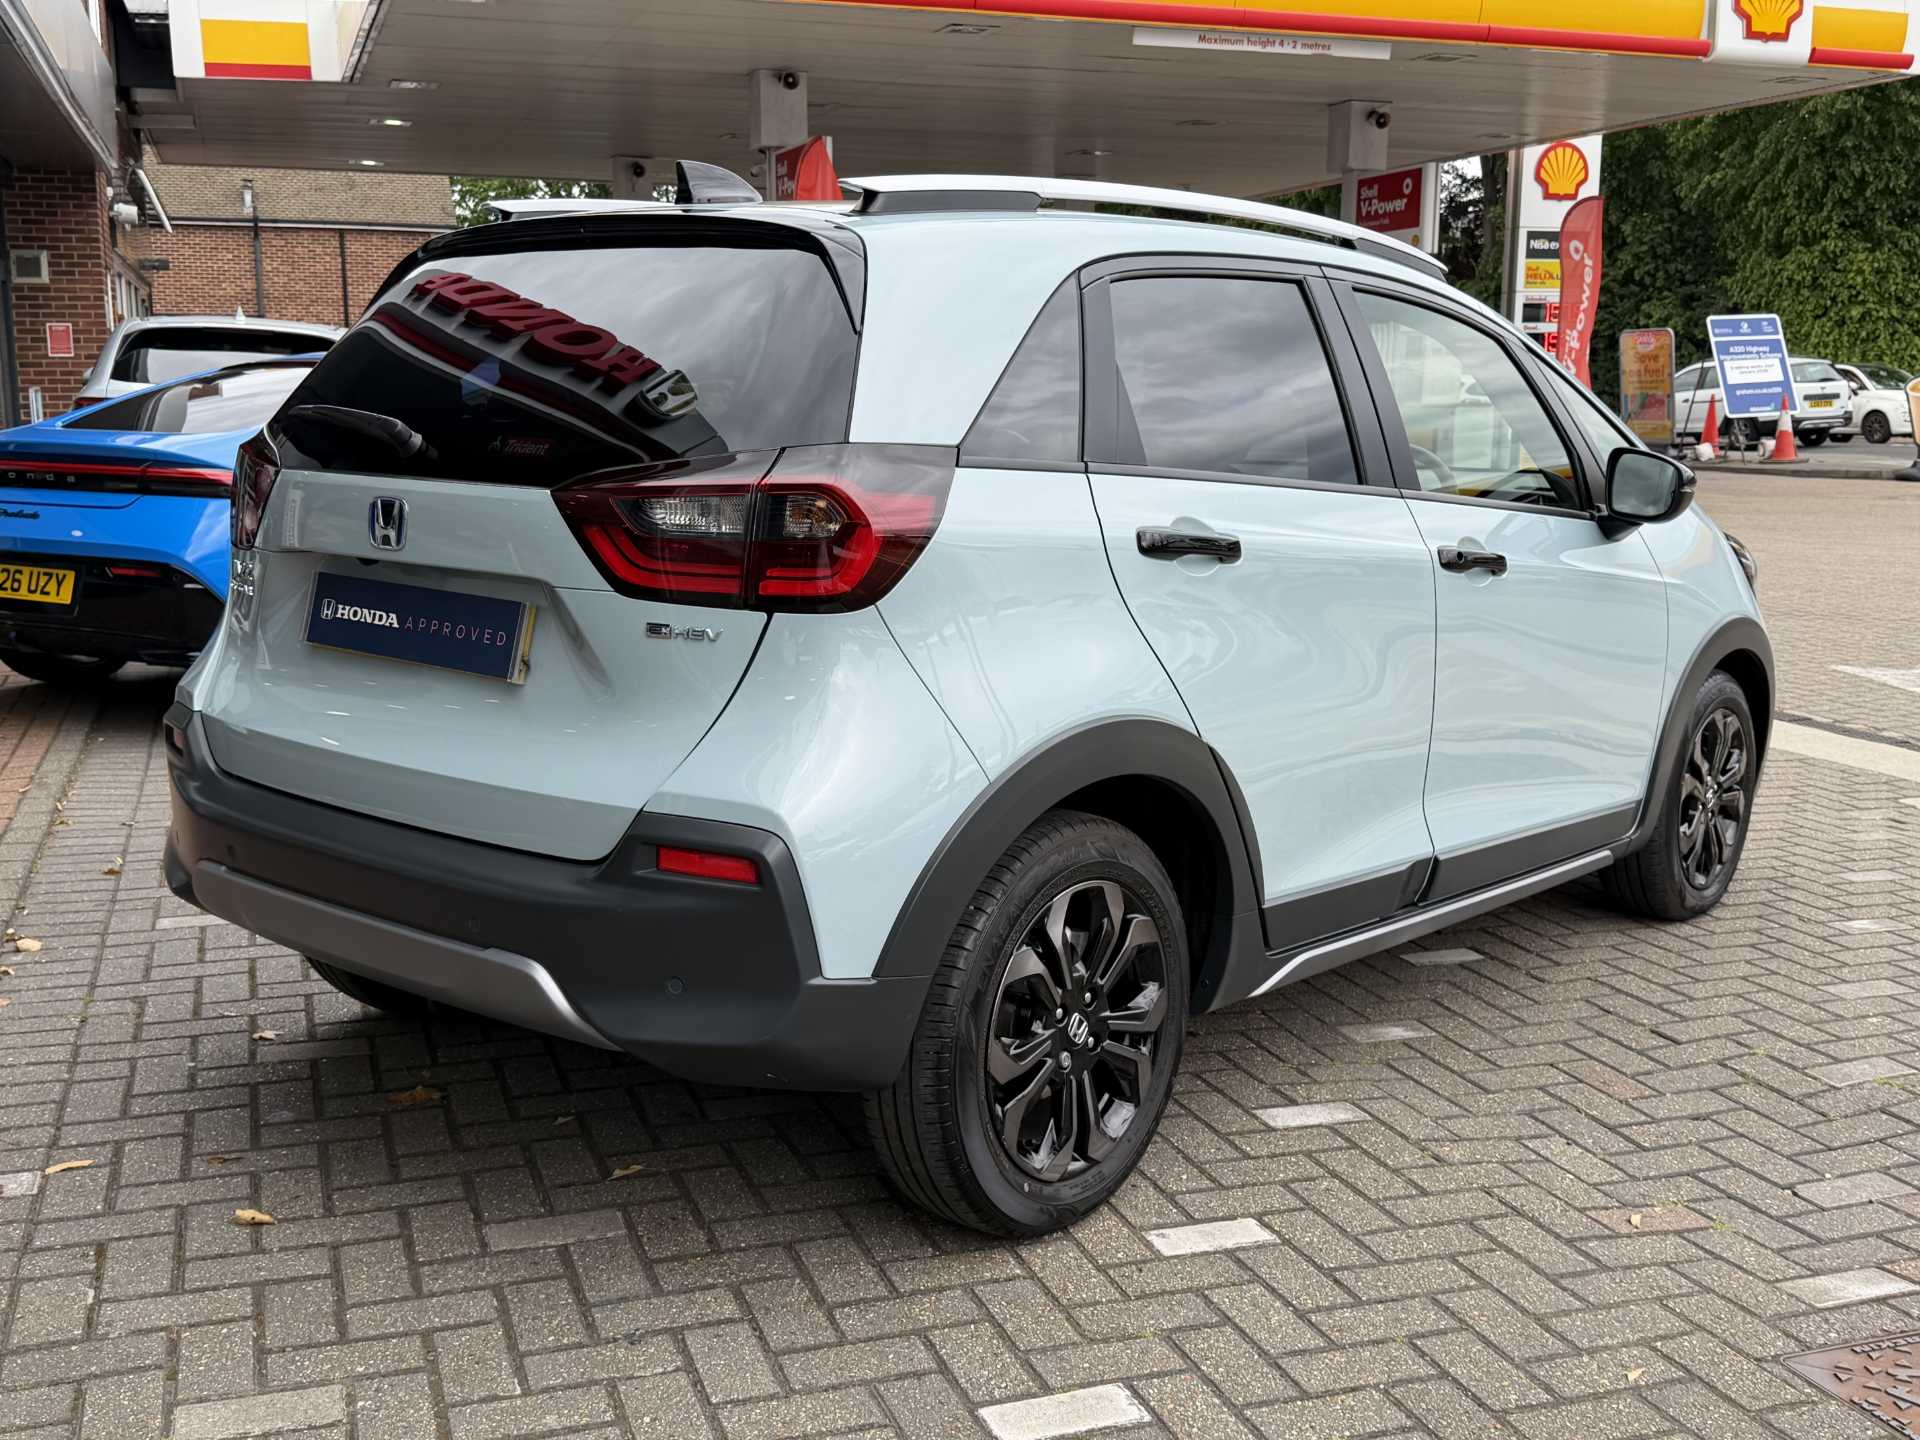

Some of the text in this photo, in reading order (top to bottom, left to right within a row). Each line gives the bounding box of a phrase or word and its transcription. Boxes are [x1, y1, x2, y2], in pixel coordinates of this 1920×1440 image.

[1198, 34, 1244, 47] Maximum
[1246, 36, 1276, 50] height
[1300, 41, 1332, 51] metres
[1360, 183, 1379, 199] Shell
[1360, 198, 1408, 217] V-Power
[1746, 345, 1770, 353] Highway
[7, 471, 76, 483] onda
[0, 567, 66, 597] 26 UZY
[335, 603, 507, 647] HONDA APPROVED
